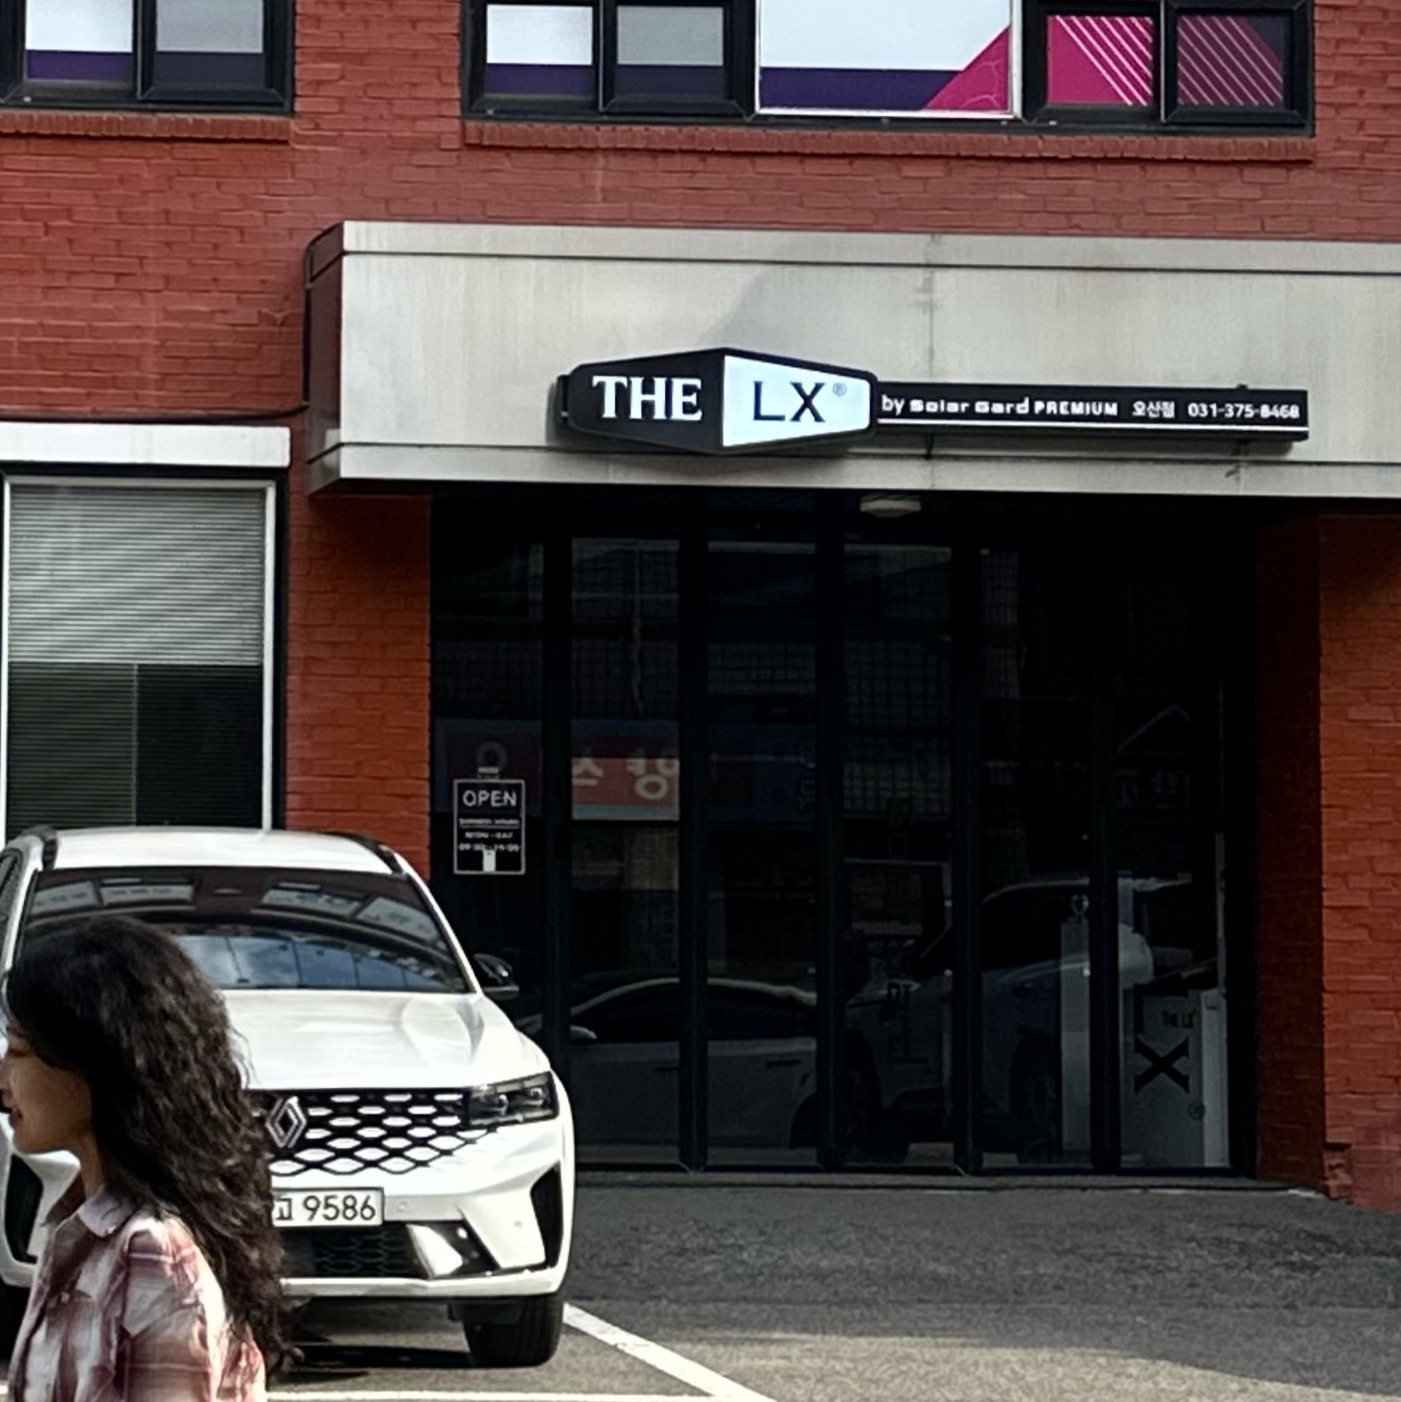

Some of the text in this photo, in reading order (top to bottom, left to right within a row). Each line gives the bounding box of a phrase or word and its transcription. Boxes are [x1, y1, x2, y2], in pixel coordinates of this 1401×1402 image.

[592, 375, 703, 421] THE
[881, 394, 905, 415] by
[909, 398, 970, 413] Solar
[974, 396, 1030, 414] Gard
[1033, 400, 1118, 416] PREMIUM
[1131, 401, 1176, 418] 오산점
[1187, 402, 1300, 419] 031-375-8468
[462, 789, 517, 807] OPEN
[302, 1195, 377, 1221] 9586
